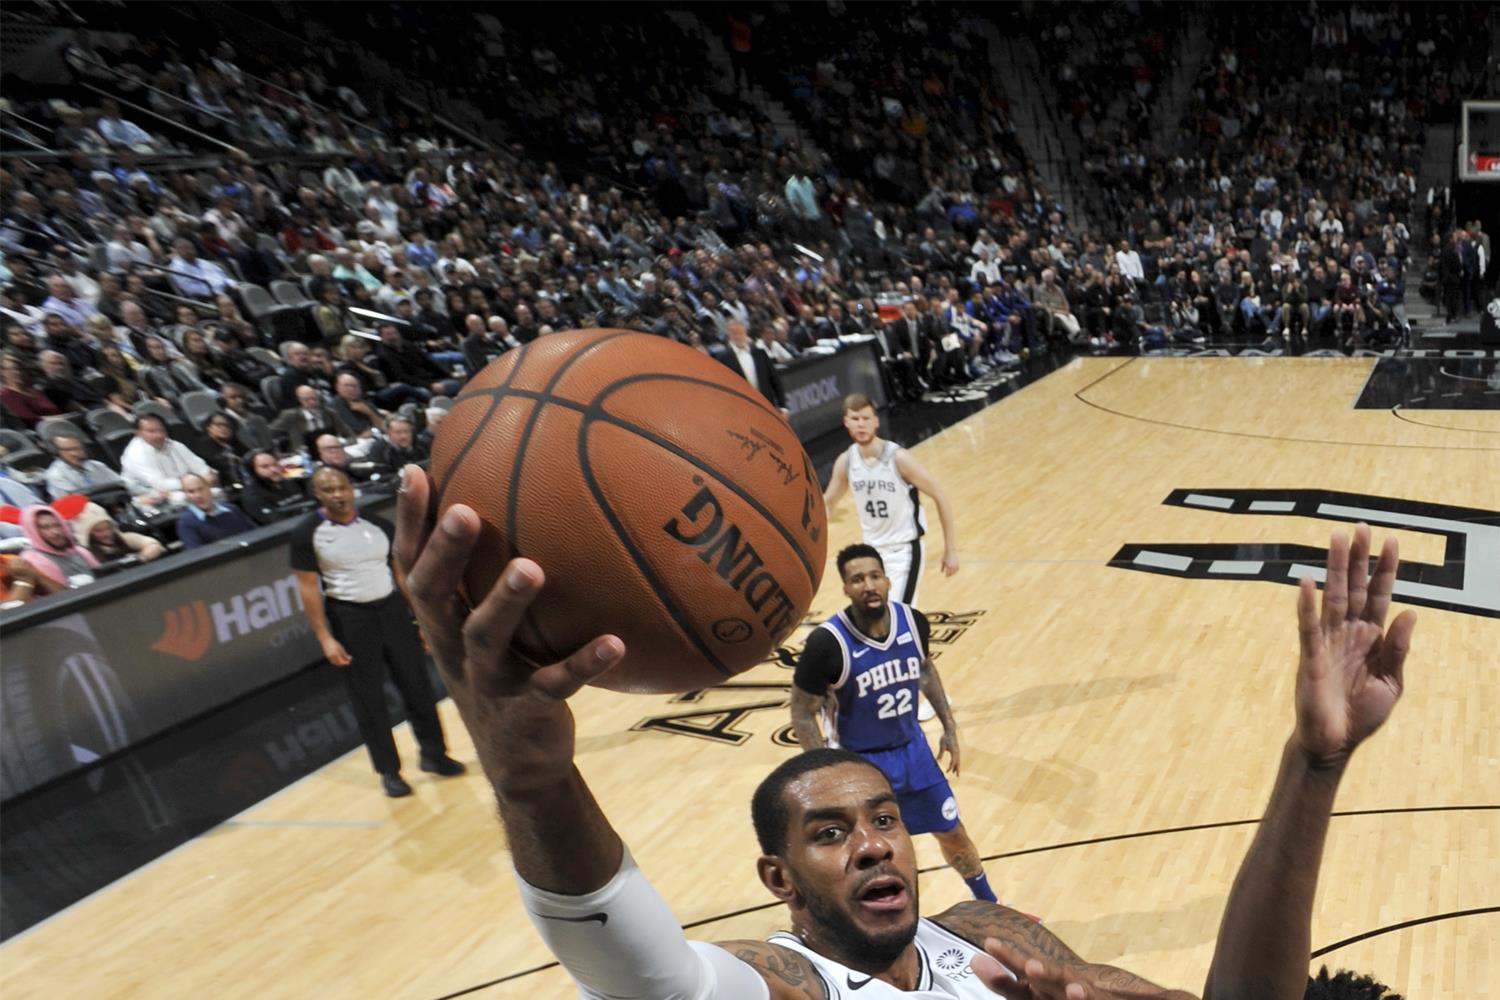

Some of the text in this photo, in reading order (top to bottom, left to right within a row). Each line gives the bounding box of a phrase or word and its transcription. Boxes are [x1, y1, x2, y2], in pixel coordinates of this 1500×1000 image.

[852, 479, 896, 495] SPURS
[865, 500, 889, 519] 42
[212, 575, 304, 642] Han
[856, 657, 920, 697] PHILA
[877, 688, 913, 720] 22
